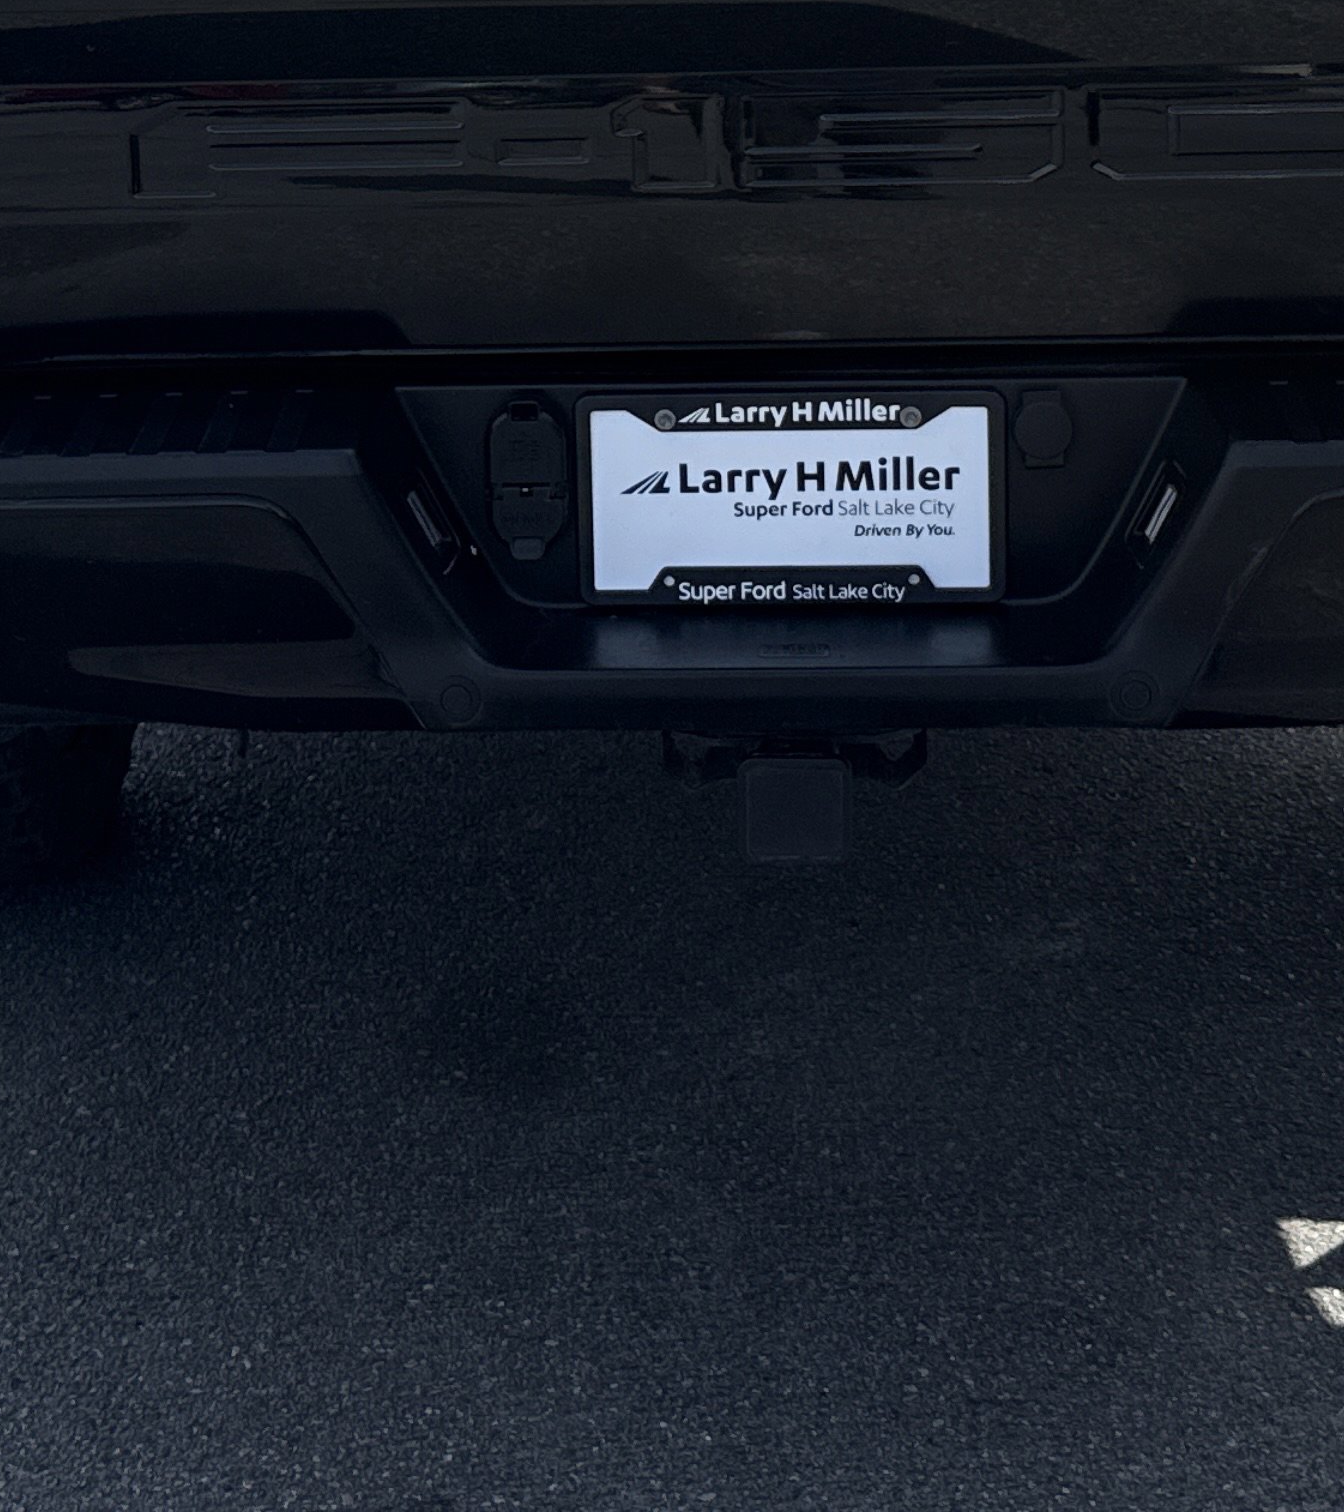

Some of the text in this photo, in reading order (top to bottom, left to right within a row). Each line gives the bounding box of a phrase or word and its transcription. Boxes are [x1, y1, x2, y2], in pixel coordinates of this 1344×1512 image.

[714, 397, 901, 428] Larry H Miller
[678, 456, 961, 500] Larry H Miller
[733, 498, 955, 521] Super Ford Salt Lake City
[853, 523, 956, 539] Driven By You.
[677, 580, 906, 605] Super Ford Salt Lake City
